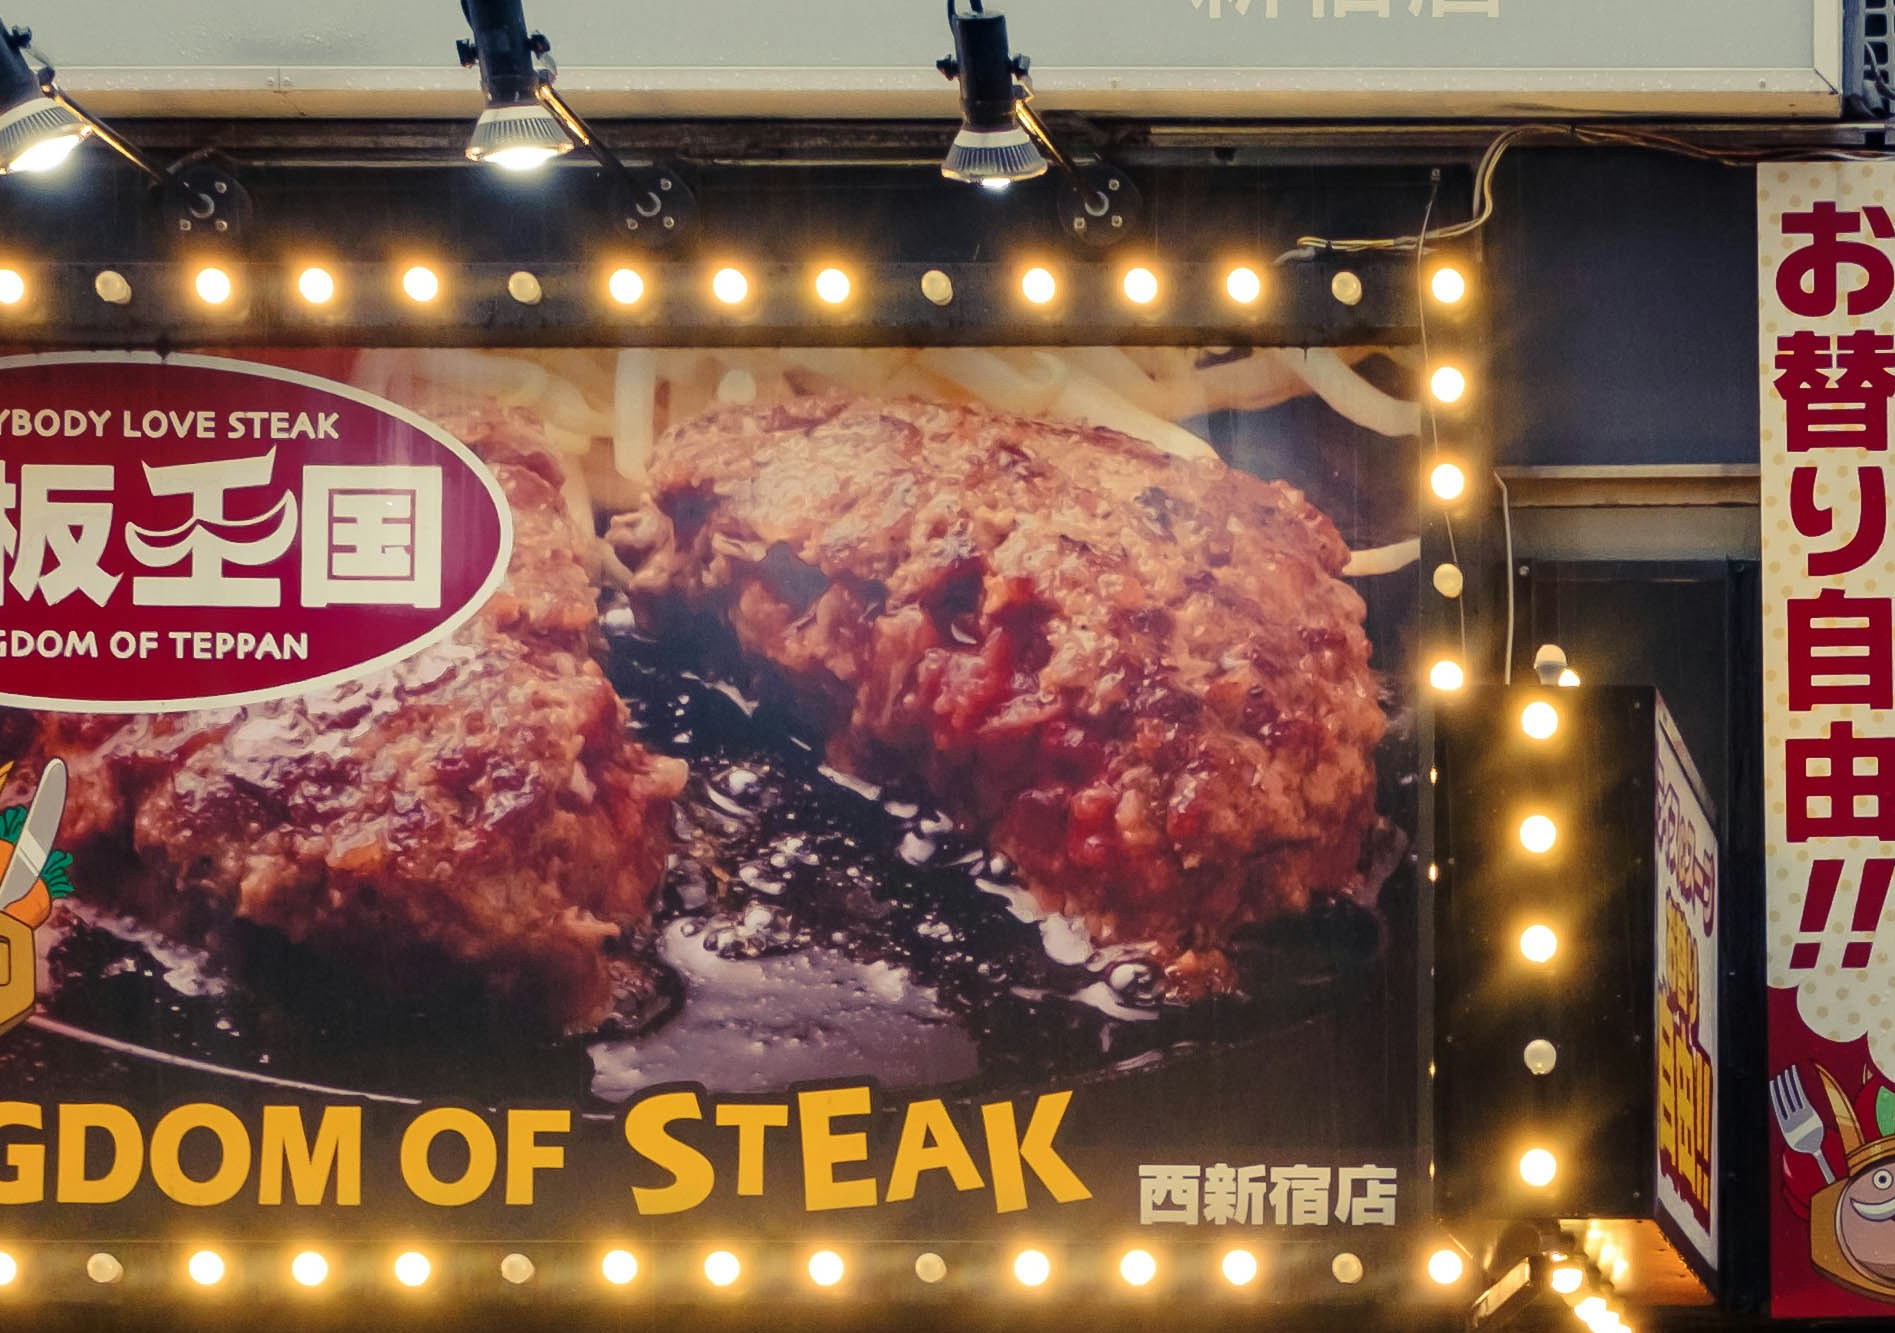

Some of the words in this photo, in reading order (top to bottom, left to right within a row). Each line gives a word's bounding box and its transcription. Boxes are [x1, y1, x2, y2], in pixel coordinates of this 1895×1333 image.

[123, 410, 217, 438] LOVE
[229, 411, 339, 440] STEAK
[110, 630, 159, 659] OF
[169, 631, 308, 661] TEPPAN
[399, 1109, 572, 1206] OF
[624, 1086, 1093, 1216] STEAK
[1139, 1163, 1398, 1227] 西新宿店
